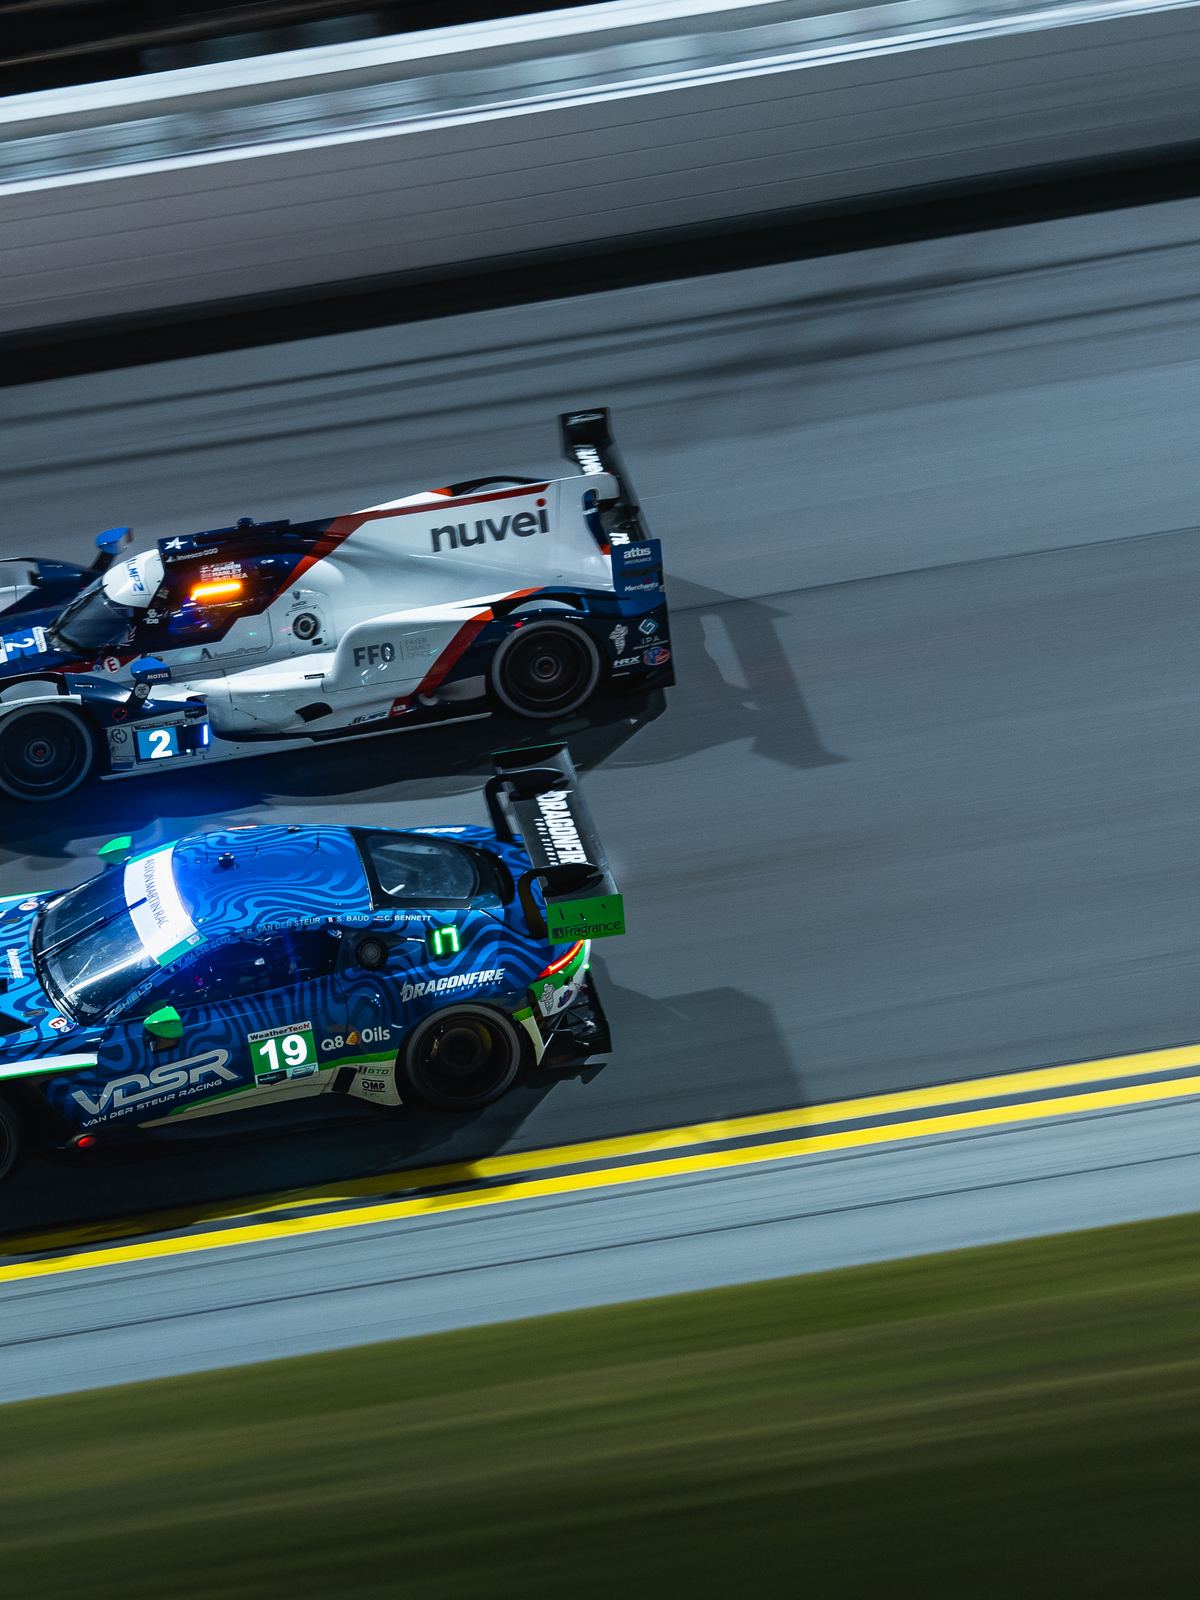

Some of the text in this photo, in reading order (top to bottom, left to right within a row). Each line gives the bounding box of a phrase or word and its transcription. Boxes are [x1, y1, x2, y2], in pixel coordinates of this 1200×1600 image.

[431, 498, 549, 553] nuvei
[5, 638, 35, 653] 2
[641, 635, 660, 645] IPA
[106, 658, 118, 673] E
[149, 730, 173, 759] 2
[536, 790, 589, 864] DRAGONFIR
[257, 924, 273, 933] VAN
[275, 921, 292, 930] DER
[294, 917, 321, 927] STEUR
[565, 920, 622, 938] Fragrance
[401, 968, 506, 1002] DRAGONFIRE
[104, 982, 153, 1023] XSHIELD
[50, 1018, 66, 1028] E
[250, 1023, 310, 1040] WeatherTech
[321, 1027, 391, 1052] Q8 Oils
[259, 1034, 308, 1070] 19
[72, 1048, 240, 1115] VDSR
[367, 1067, 390, 1075] GTD
[362, 1081, 385, 1091] OMP
[82, 1079, 223, 1127] VAN DER STEUR RACING
